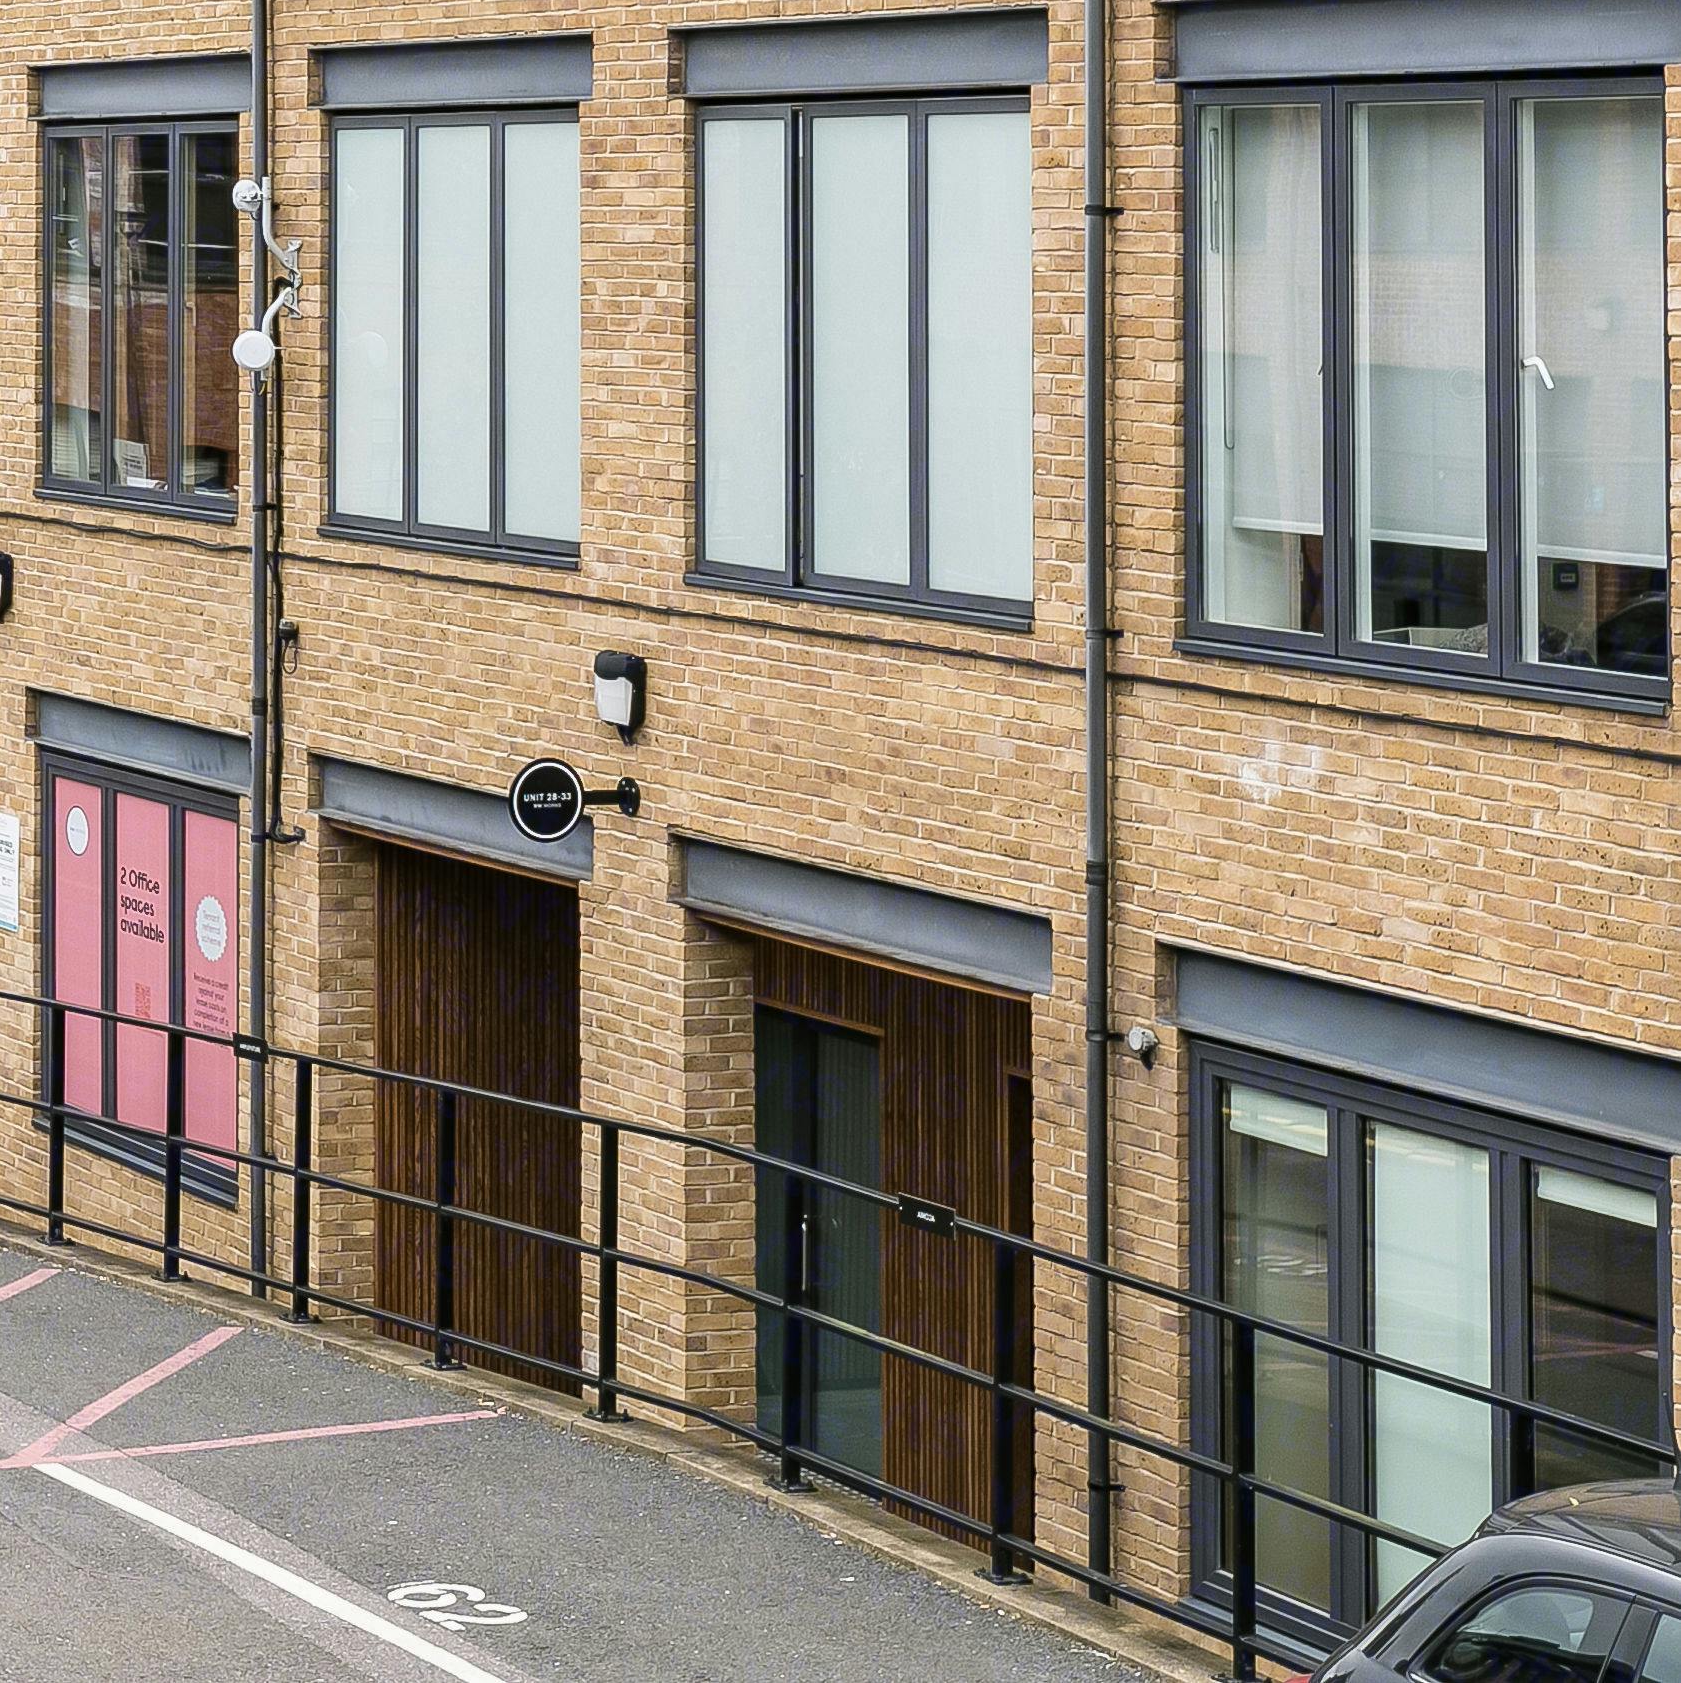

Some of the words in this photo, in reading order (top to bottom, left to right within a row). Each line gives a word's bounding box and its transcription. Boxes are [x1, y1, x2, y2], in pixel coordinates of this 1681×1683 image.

[523, 793, 545, 802] UNIT
[546, 792, 572, 801] 28-33
[120, 866, 127, 885] 2
[128, 869, 160, 895] Office
[120, 894, 155, 916] spaces
[120, 918, 165, 944] available
[388, 1579, 529, 1631] 62
